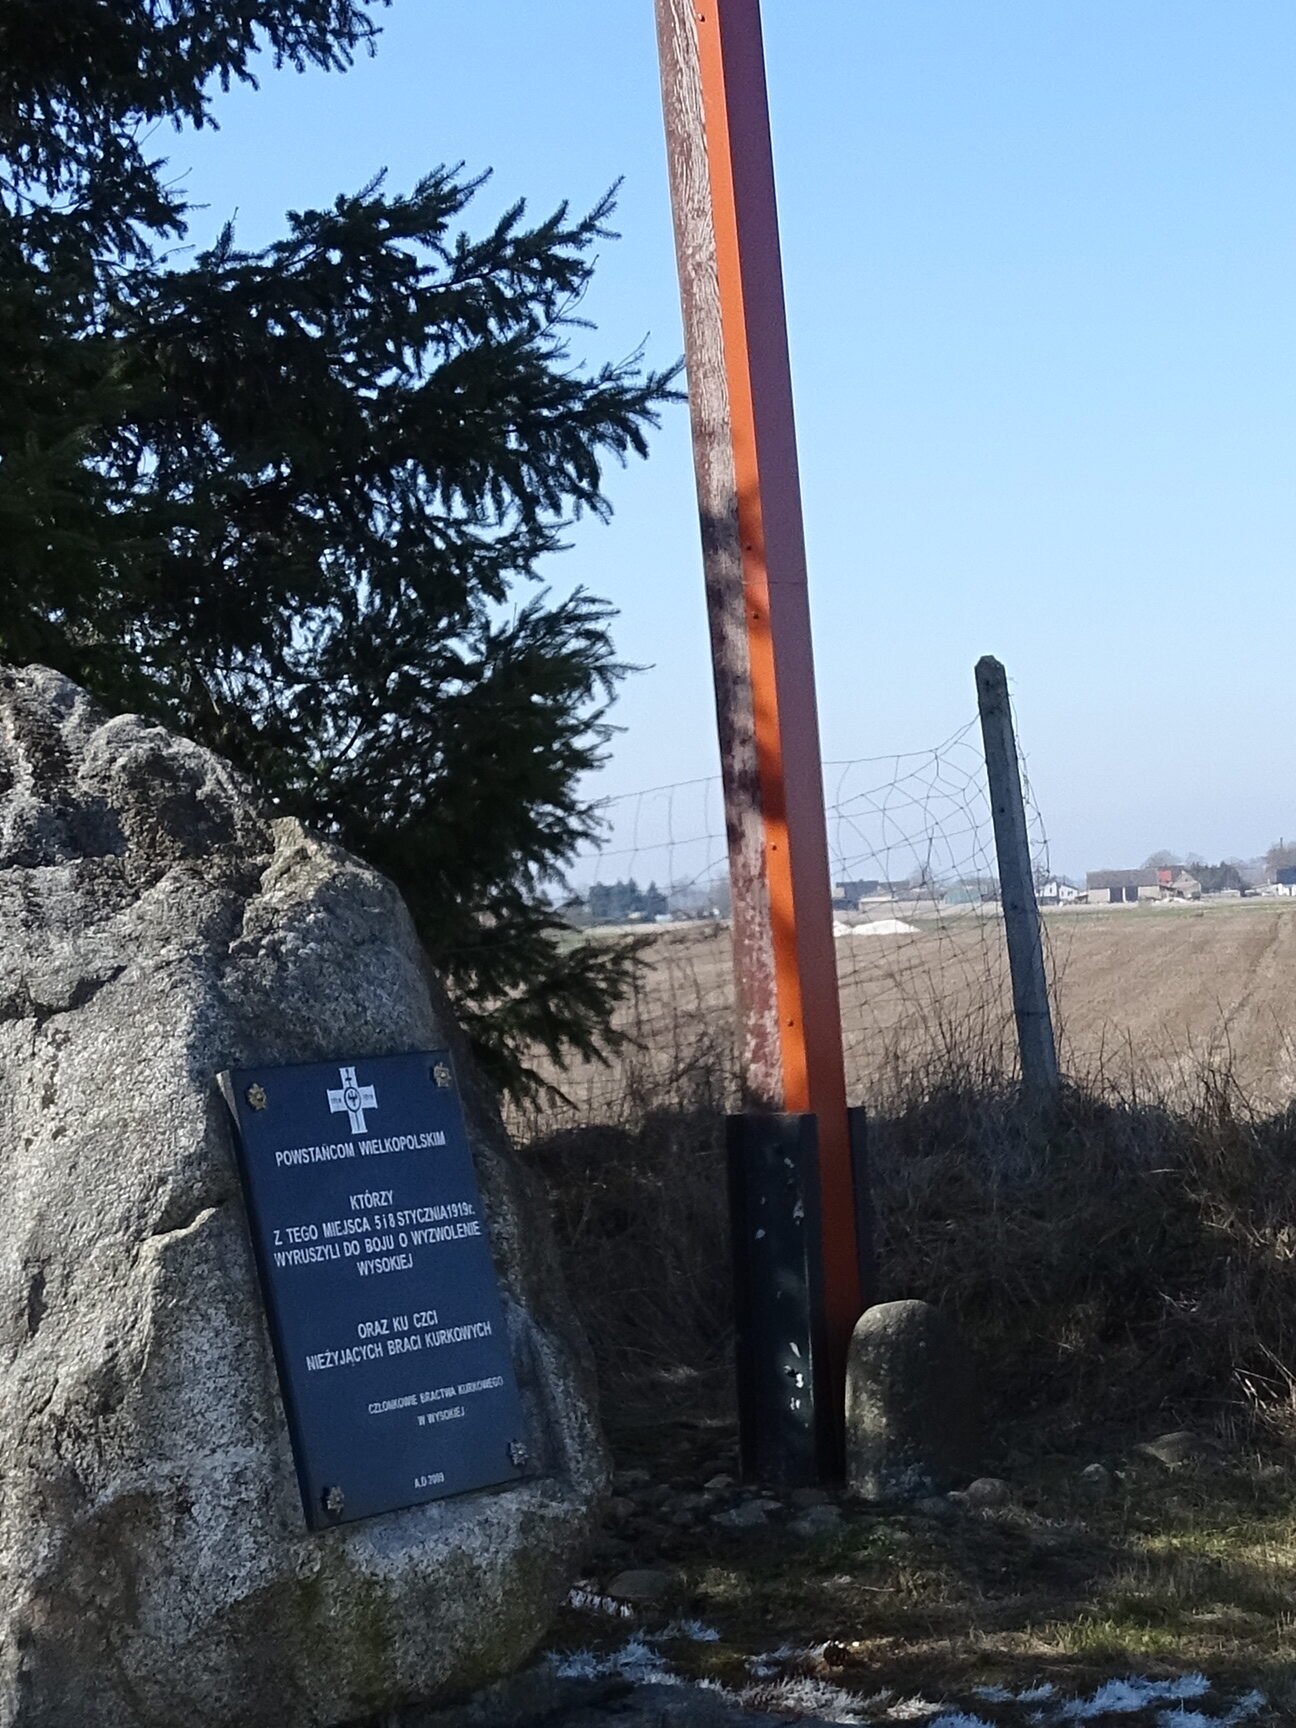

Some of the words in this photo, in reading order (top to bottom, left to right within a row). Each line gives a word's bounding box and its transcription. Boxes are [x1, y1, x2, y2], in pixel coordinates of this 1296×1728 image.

[275, 1142, 355, 1167] POWSTAŃCOM
[358, 1131, 446, 1156] WIELKOPOLSKIM
[349, 1189, 393, 1210] KTÓRZY
[274, 1230, 283, 1246] Z
[286, 1225, 319, 1243] TEGO
[322, 1217, 371, 1238] MIEJSCA
[375, 1216, 382, 1229] 5
[382, 1214, 388, 1229] i
[388, 1213, 396, 1228] 8
[274, 1243, 341, 1267] WYRUSZYLI
[343, 1240, 360, 1257] DO
[365, 1234, 395, 1254] BOJU
[398, 1231, 408, 1248] O
[410, 1221, 482, 1246] WYZWOLENIE
[357, 1253, 413, 1276] WYSOKIEJ
[357, 1319, 390, 1340] ORAZ
[392, 1316, 409, 1333] KU
[413, 1309, 439, 1328] CZCI
[306, 1342, 384, 1371] NIEŻYJĄCYCH
[387, 1334, 423, 1356] BRACI
[425, 1321, 492, 1348] KURKOWYCH
